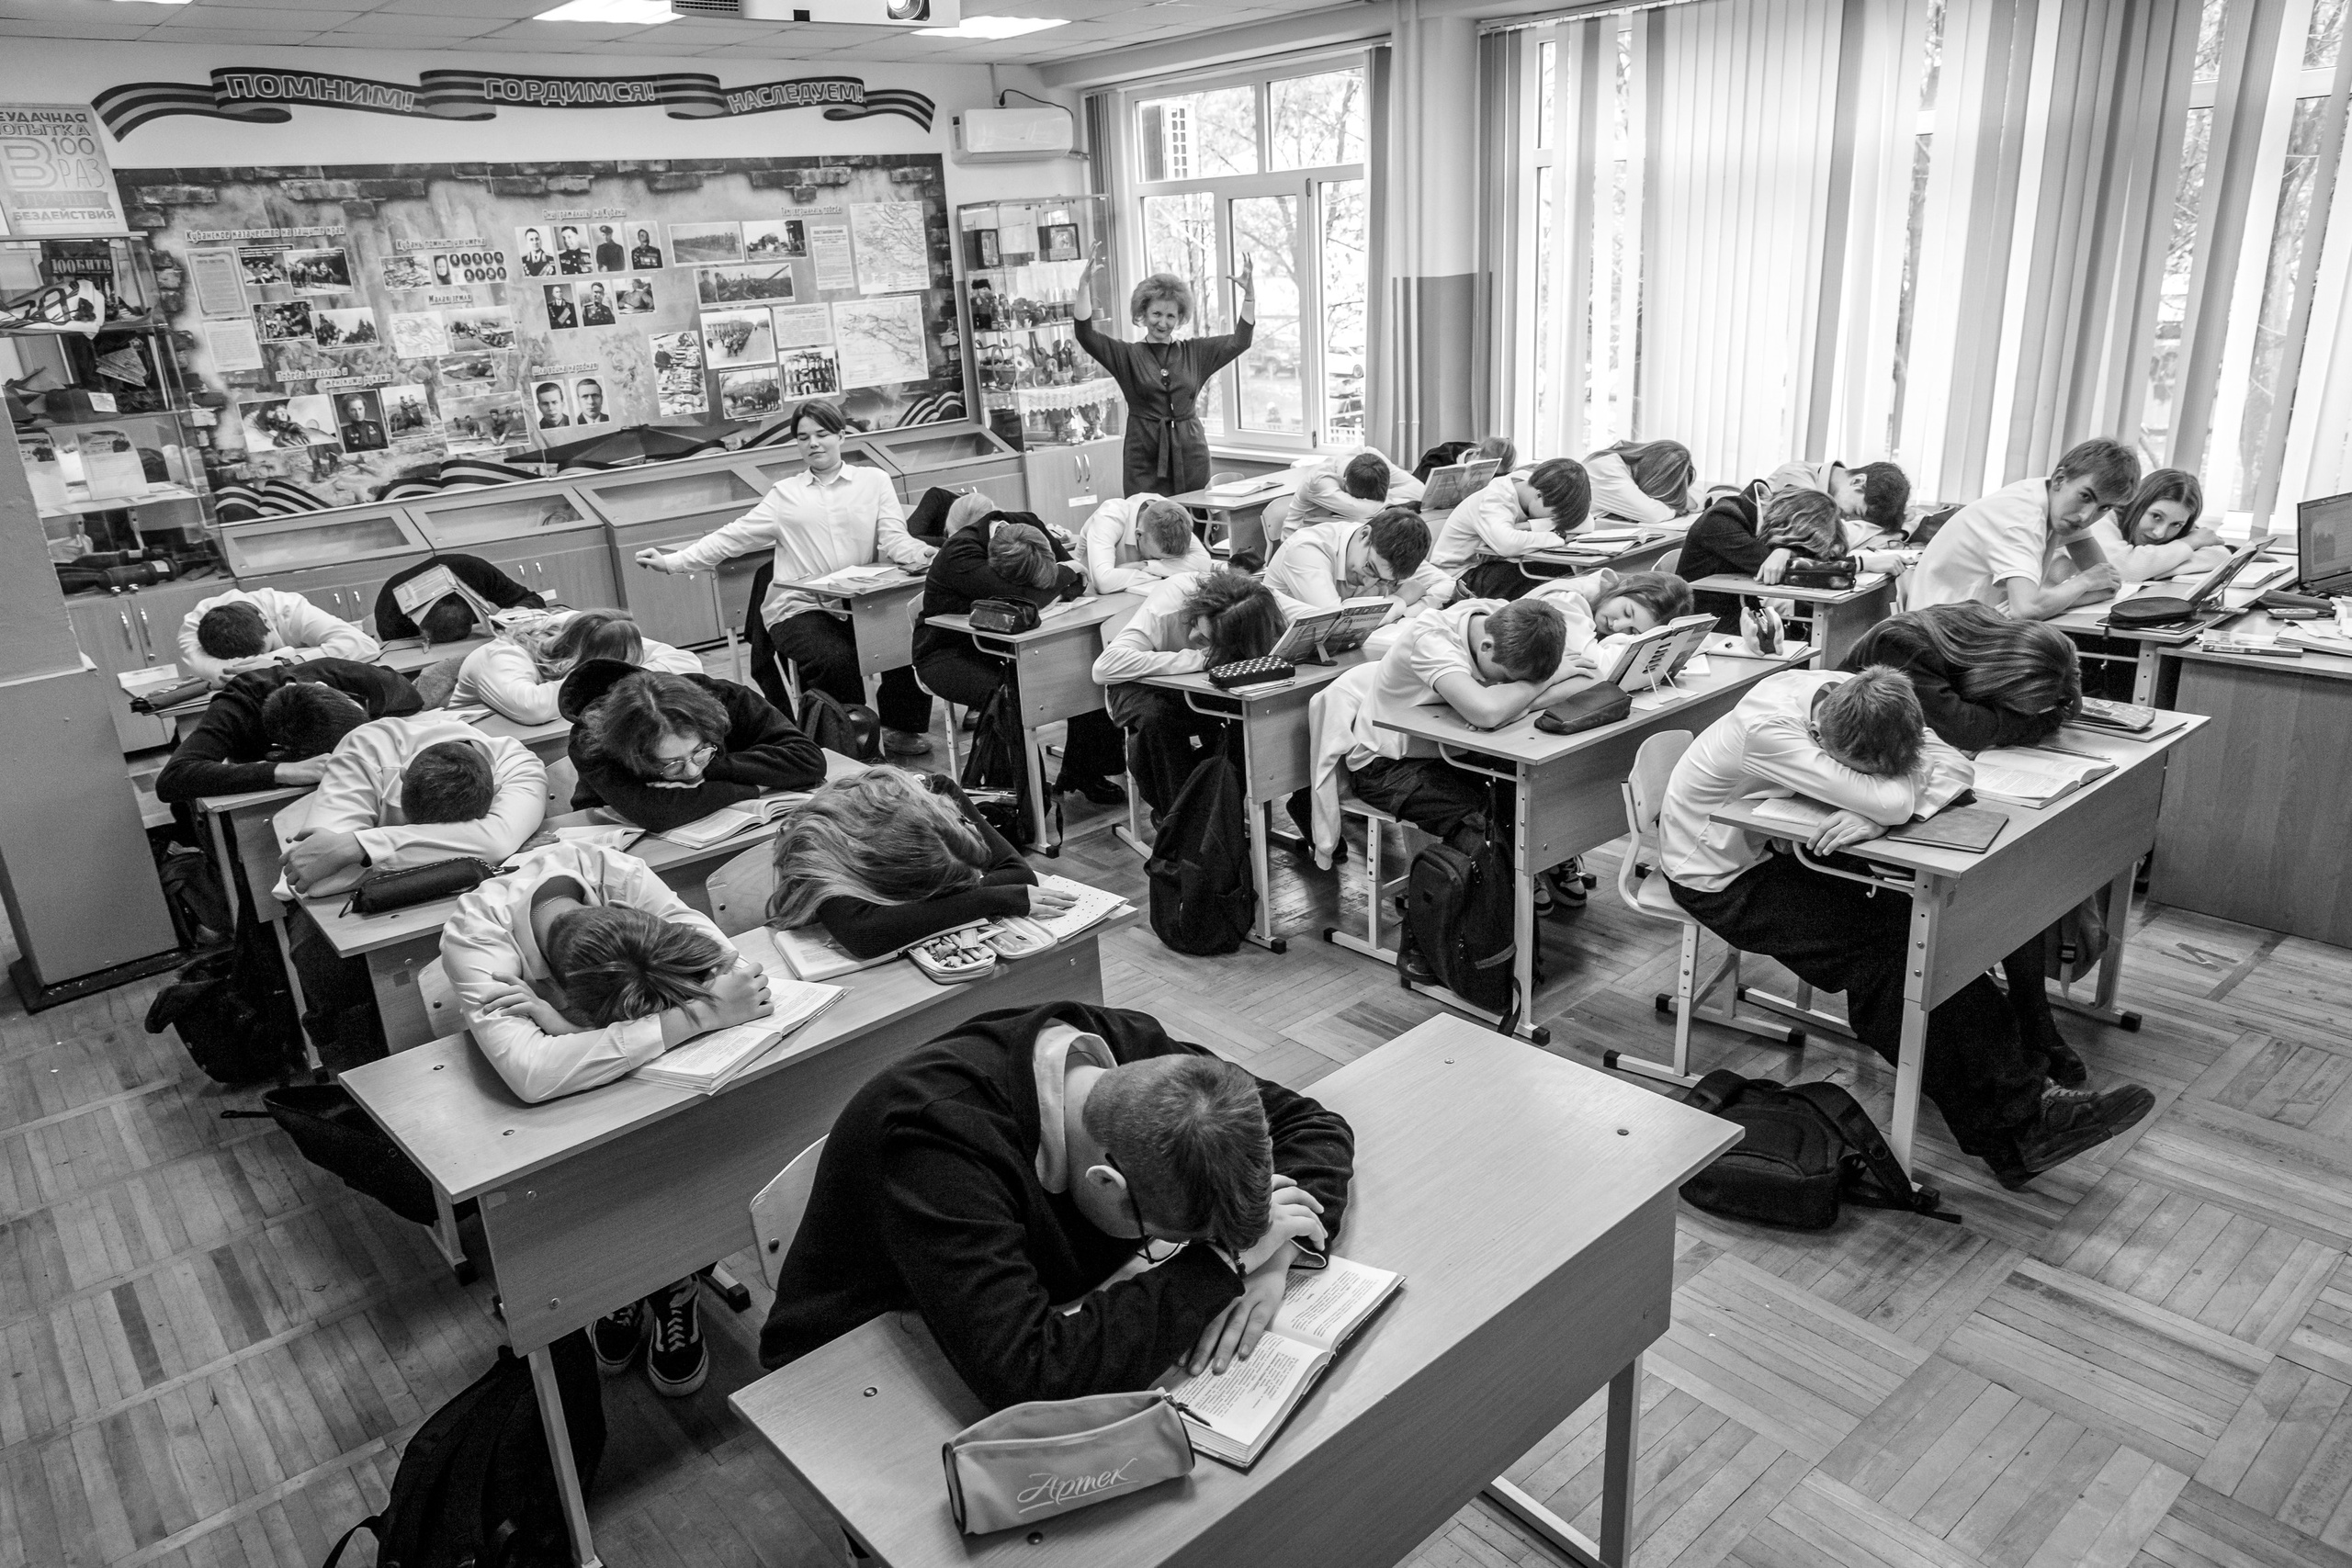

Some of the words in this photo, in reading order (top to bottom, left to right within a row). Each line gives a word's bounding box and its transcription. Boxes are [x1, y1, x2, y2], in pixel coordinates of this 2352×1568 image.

[225, 74, 414, 112] ПОМНИМ!
[484, 78, 656, 106] ГОРДИМСЯ!
[727, 82, 865, 114] НАСЛЕДУЕМ!
[0, 111, 88, 123] ЕУДАЧНАЯ
[0, 123, 91, 136] ОПЫТКА
[0, 137, 58, 189] В
[51, 137, 96, 155] 100
[58, 158, 106, 187] РАЗ
[12, 209, 117, 221] БЕЗДЕЙСТВИЯ
[186, 230, 231, 243] Кубанское
[231, 229, 280, 240] казачество
[280, 228, 292, 237] на
[51, 259, 75, 273] 100
[75, 259, 111, 271] БИТВ
[1017, 1458, 1138, 1505] Артек
